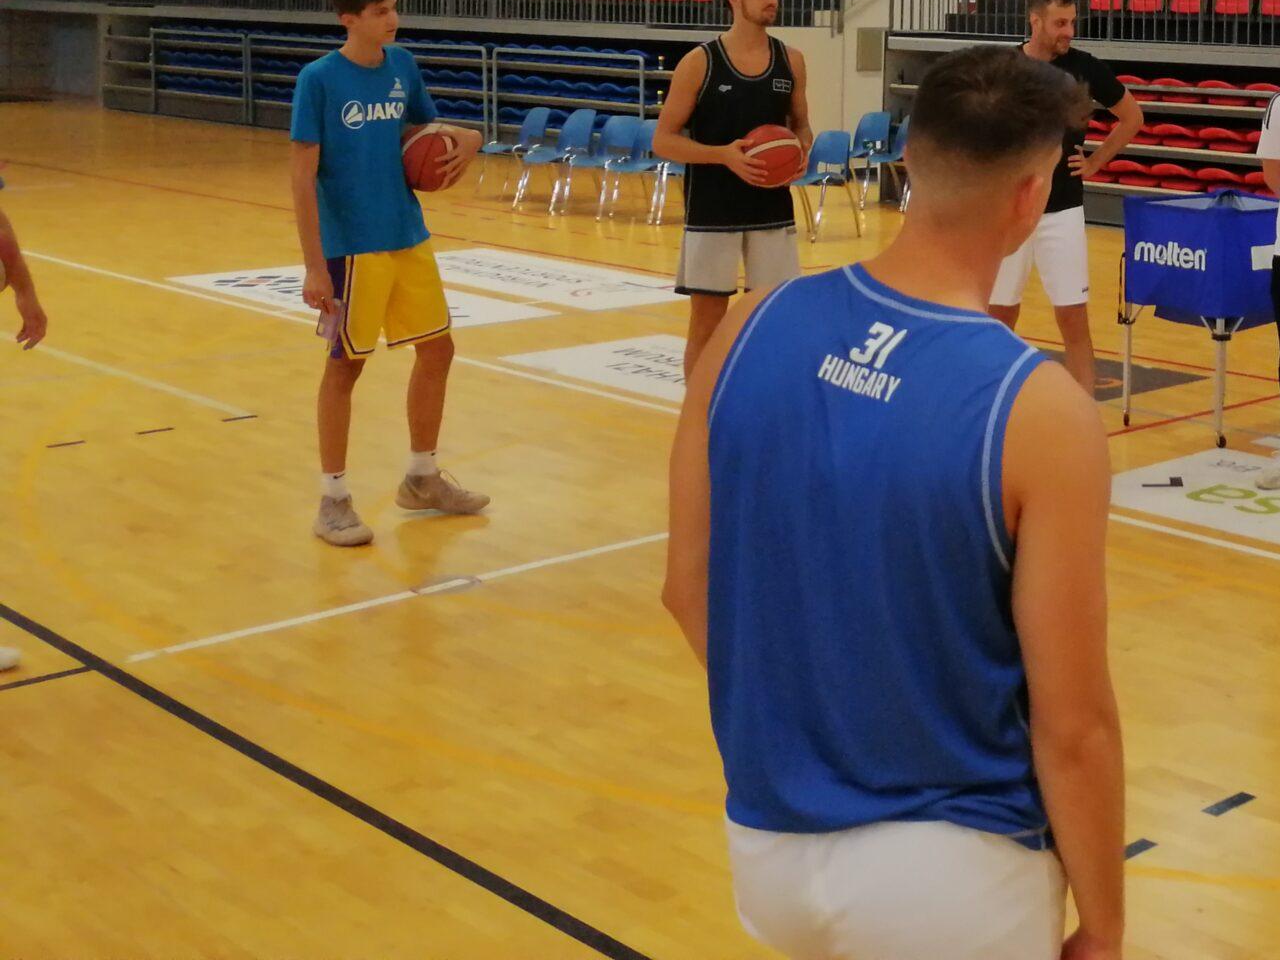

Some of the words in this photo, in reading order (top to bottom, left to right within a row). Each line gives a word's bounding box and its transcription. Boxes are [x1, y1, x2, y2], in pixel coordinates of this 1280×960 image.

[366, 102, 404, 121] JAKO
[1134, 241, 1206, 272] molten
[850, 321, 908, 370] 31
[818, 353, 901, 403] HUNGARY
